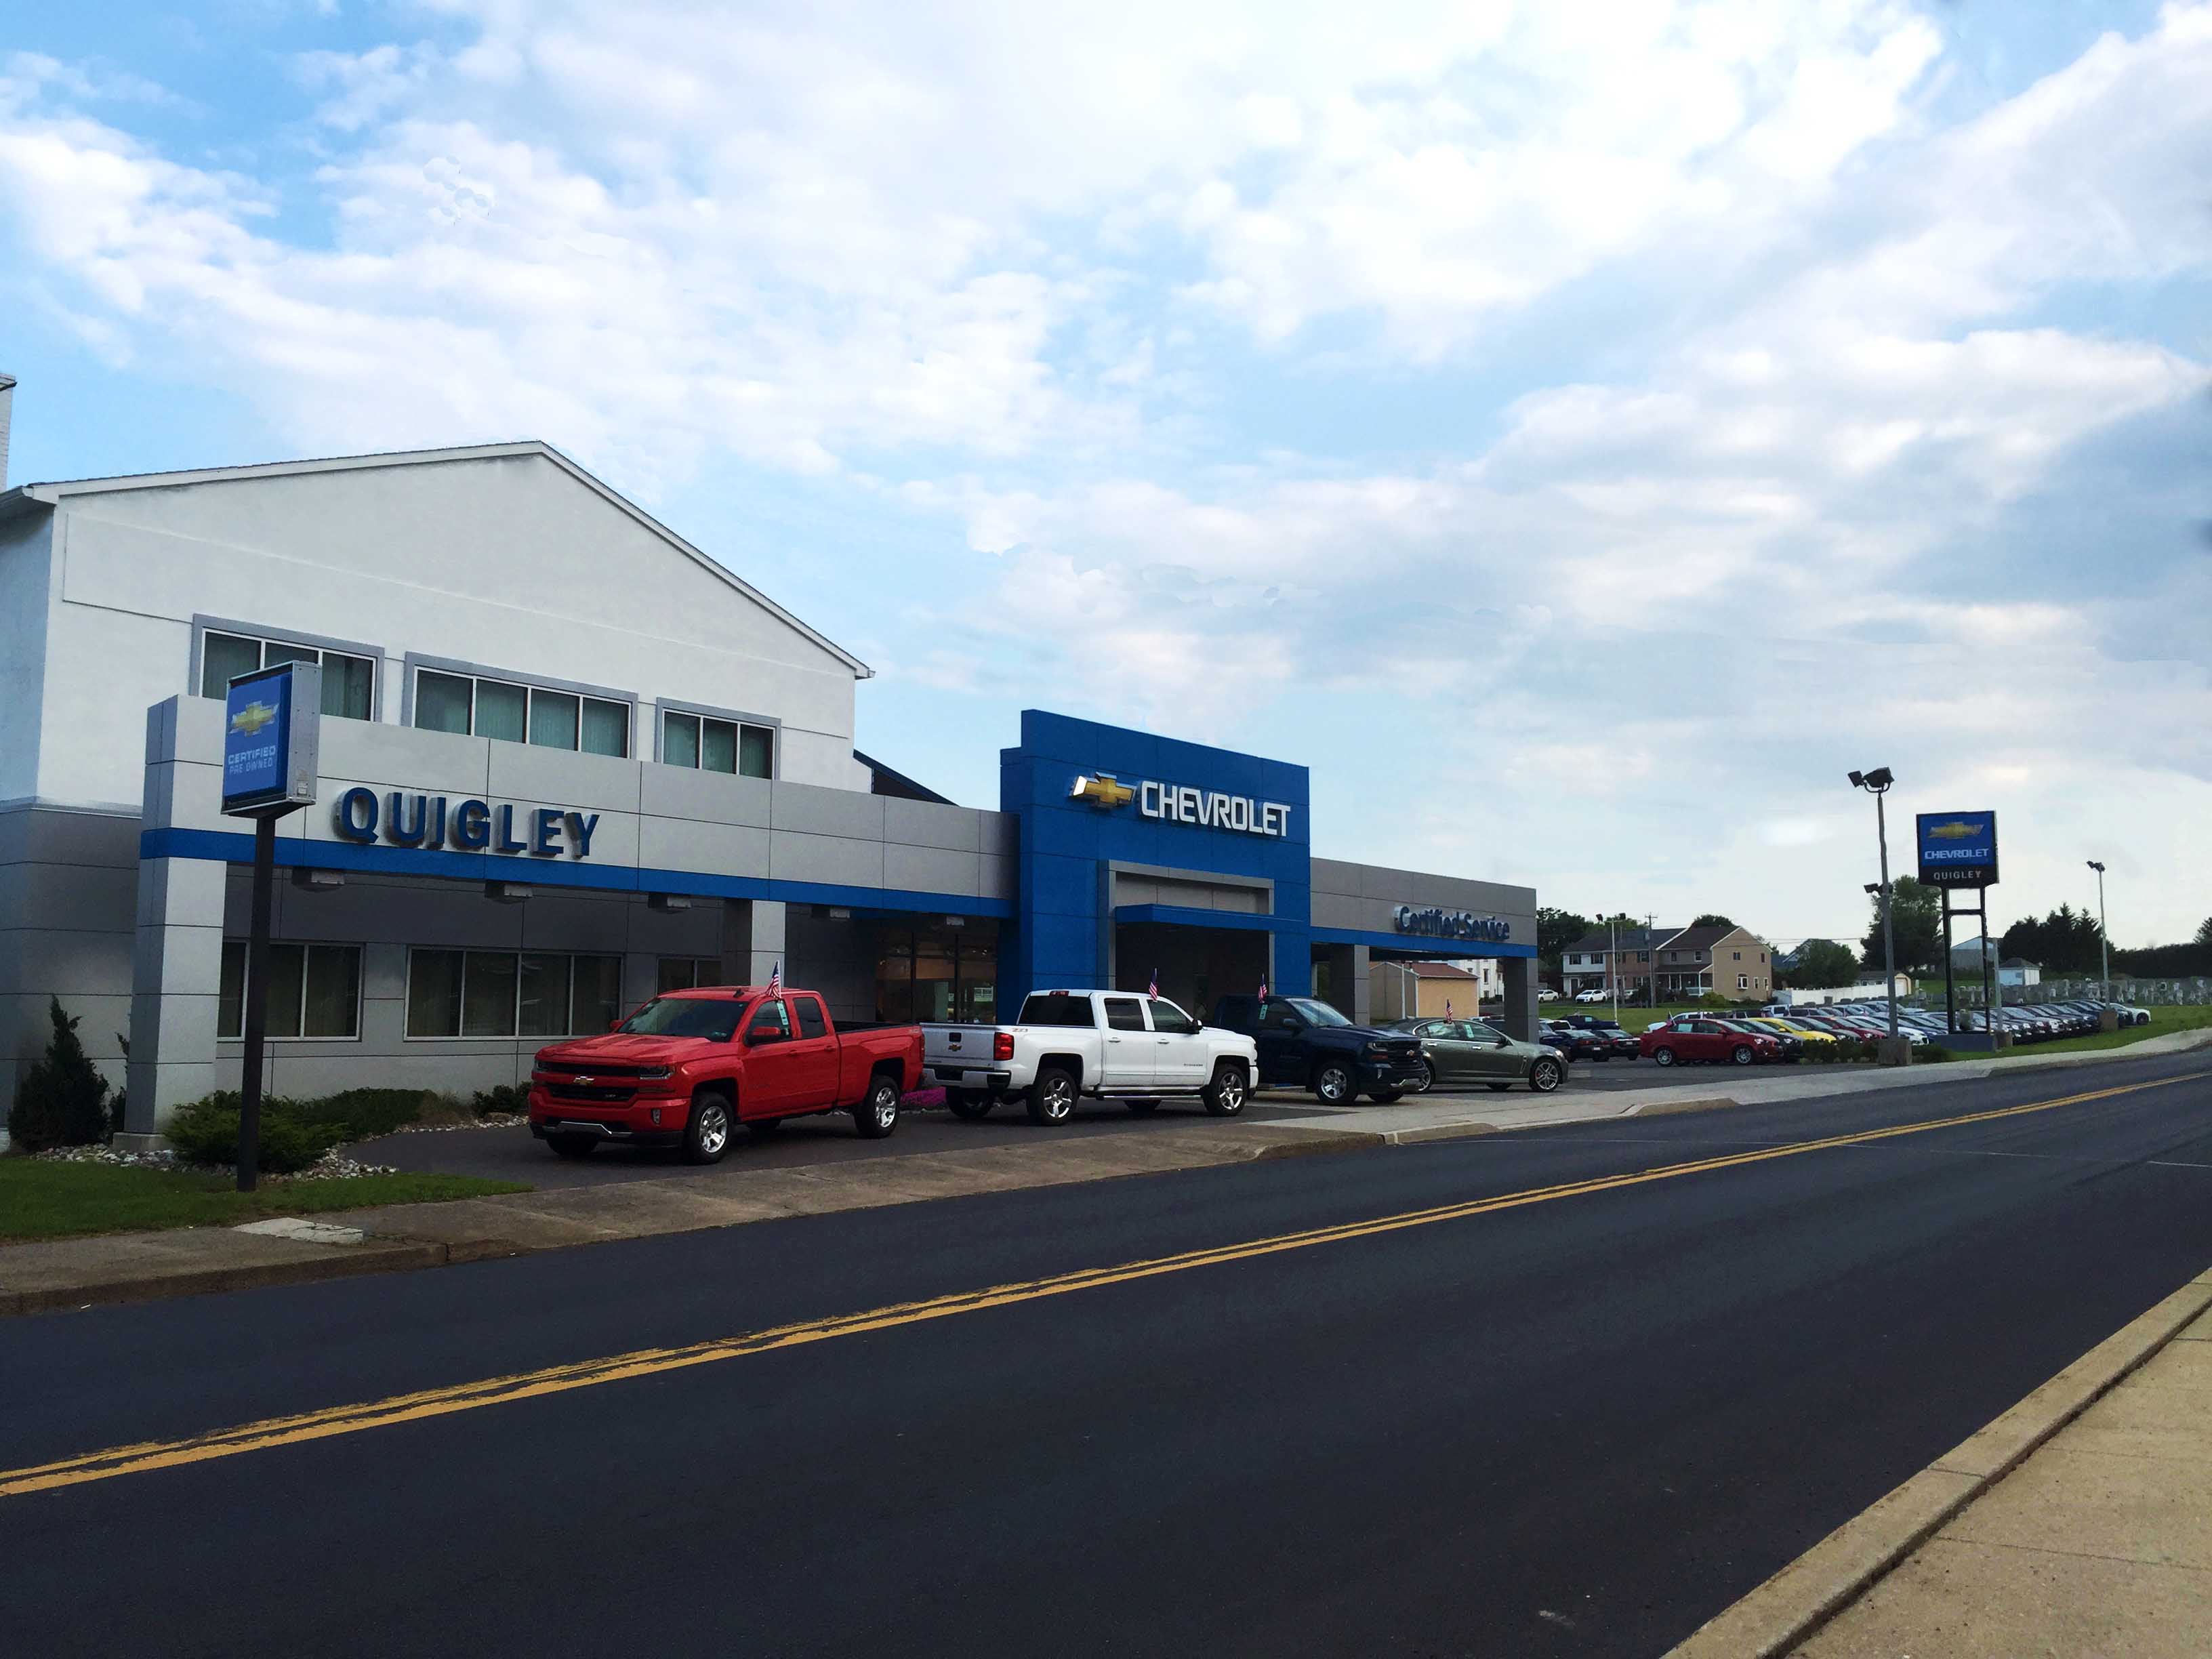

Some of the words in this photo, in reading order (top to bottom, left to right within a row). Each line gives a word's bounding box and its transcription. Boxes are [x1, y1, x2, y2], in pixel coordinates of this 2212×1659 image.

[228, 745, 276, 765] CERTIFIED
[1141, 780, 1291, 836] CHEVROLET
[336, 787, 600, 857] QUIGLEY
[1924, 848, 1990, 859] CHEVROLET
[1933, 870, 1982, 880] QUIGLEY
[1398, 905, 1460, 936] Certified
[1463, 913, 1510, 940] Service
